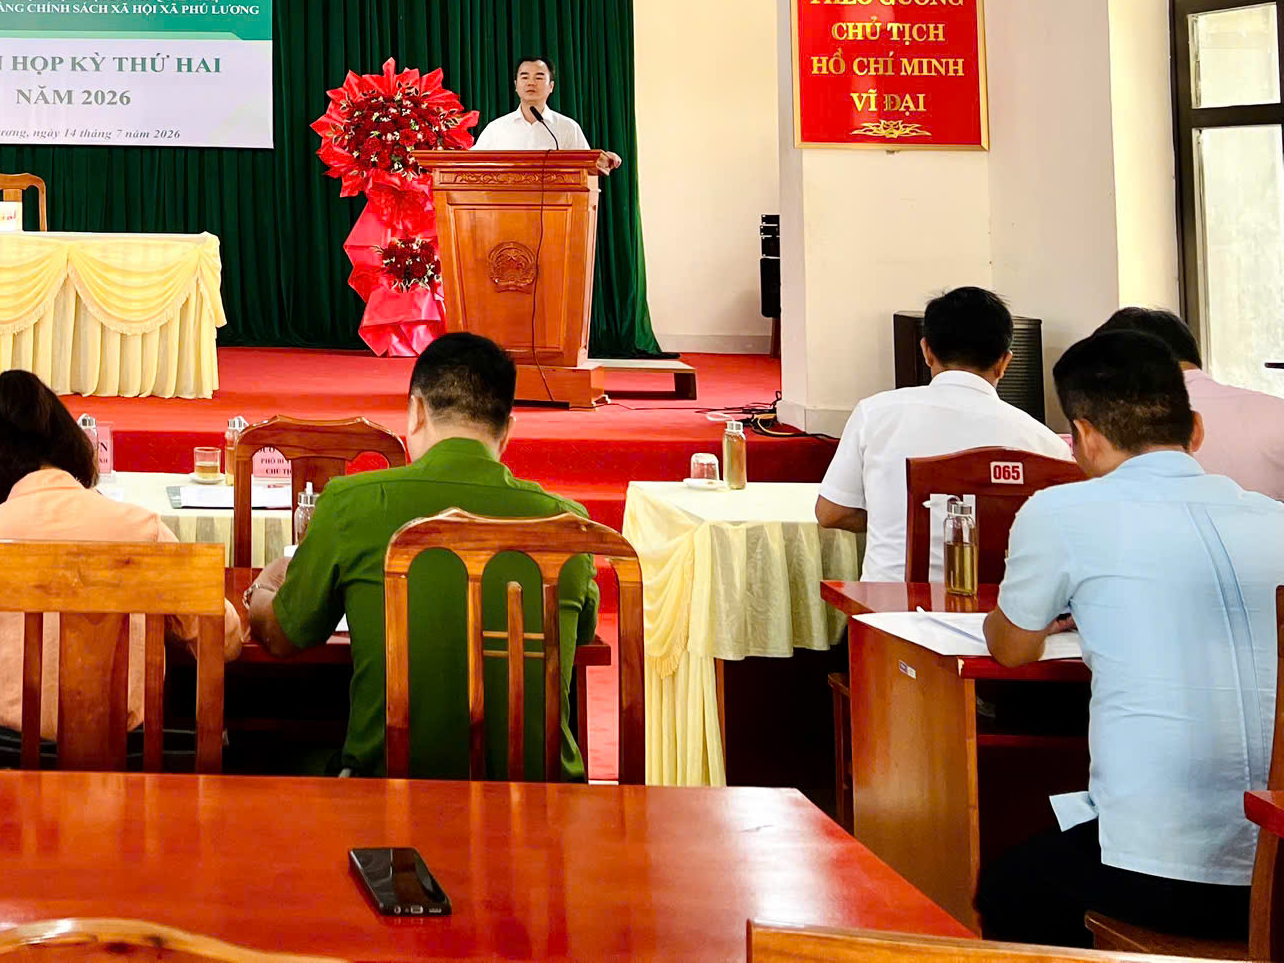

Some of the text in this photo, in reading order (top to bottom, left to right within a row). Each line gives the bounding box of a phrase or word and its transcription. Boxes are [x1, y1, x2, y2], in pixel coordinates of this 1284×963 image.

[27, 1, 70, 13] CHÍNH
[72, 2, 108, 13] SÁCH
[111, 3, 129, 14] XÃ
[132, 3, 156, 15] HỘI
[160, 3, 178, 14] XÃ
[181, 3, 208, 14] PHÚ
[211, 4, 260, 15] LƯƠNG
[831, 16, 946, 45] CHỦ TỊCH
[11, 55, 64, 75] HỌP
[70, 52, 106, 72] KỲ
[112, 52, 170, 73] THỨ
[176, 57, 221, 73] HAI
[852, 50, 895, 75] CHÍ
[900, 58, 965, 76] MINH
[15, 85, 131, 106] NĂM 2026
[850, 88, 927, 116] VĨ ĐẠI
[64, 128, 77, 137] 14
[153, 129, 181, 139] 2026
[993, 465, 1021, 481] 065
